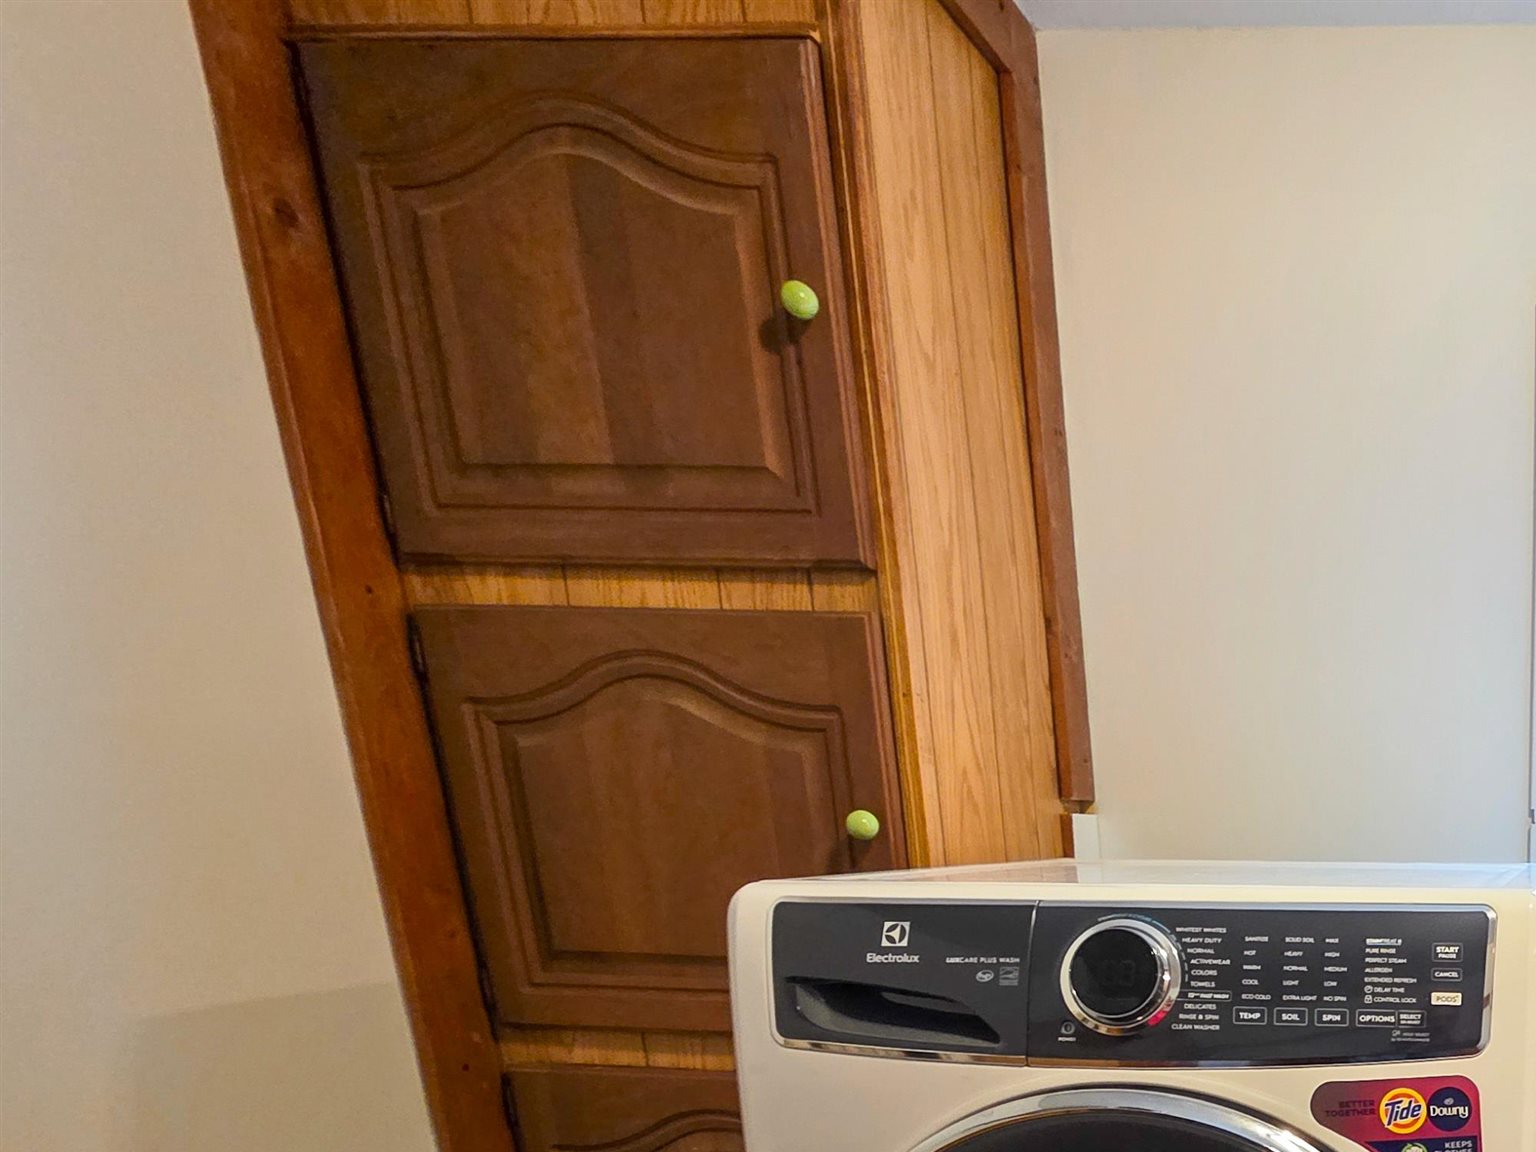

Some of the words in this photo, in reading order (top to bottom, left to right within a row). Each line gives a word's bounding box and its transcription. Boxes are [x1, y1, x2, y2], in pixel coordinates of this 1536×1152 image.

[866, 952, 920, 963] Electrolux
[1281, 1013, 1300, 1021] SOIL
[1359, 1014, 1395, 1022] OPTIONS
[1338, 1100, 1376, 1108] BETTER
[1325, 1108, 1377, 1117] TOGETHER
[1384, 1098, 1422, 1128] Tide
[1430, 1105, 1469, 1118] Downy
[1444, 1140, 1473, 1148] KEEPS
